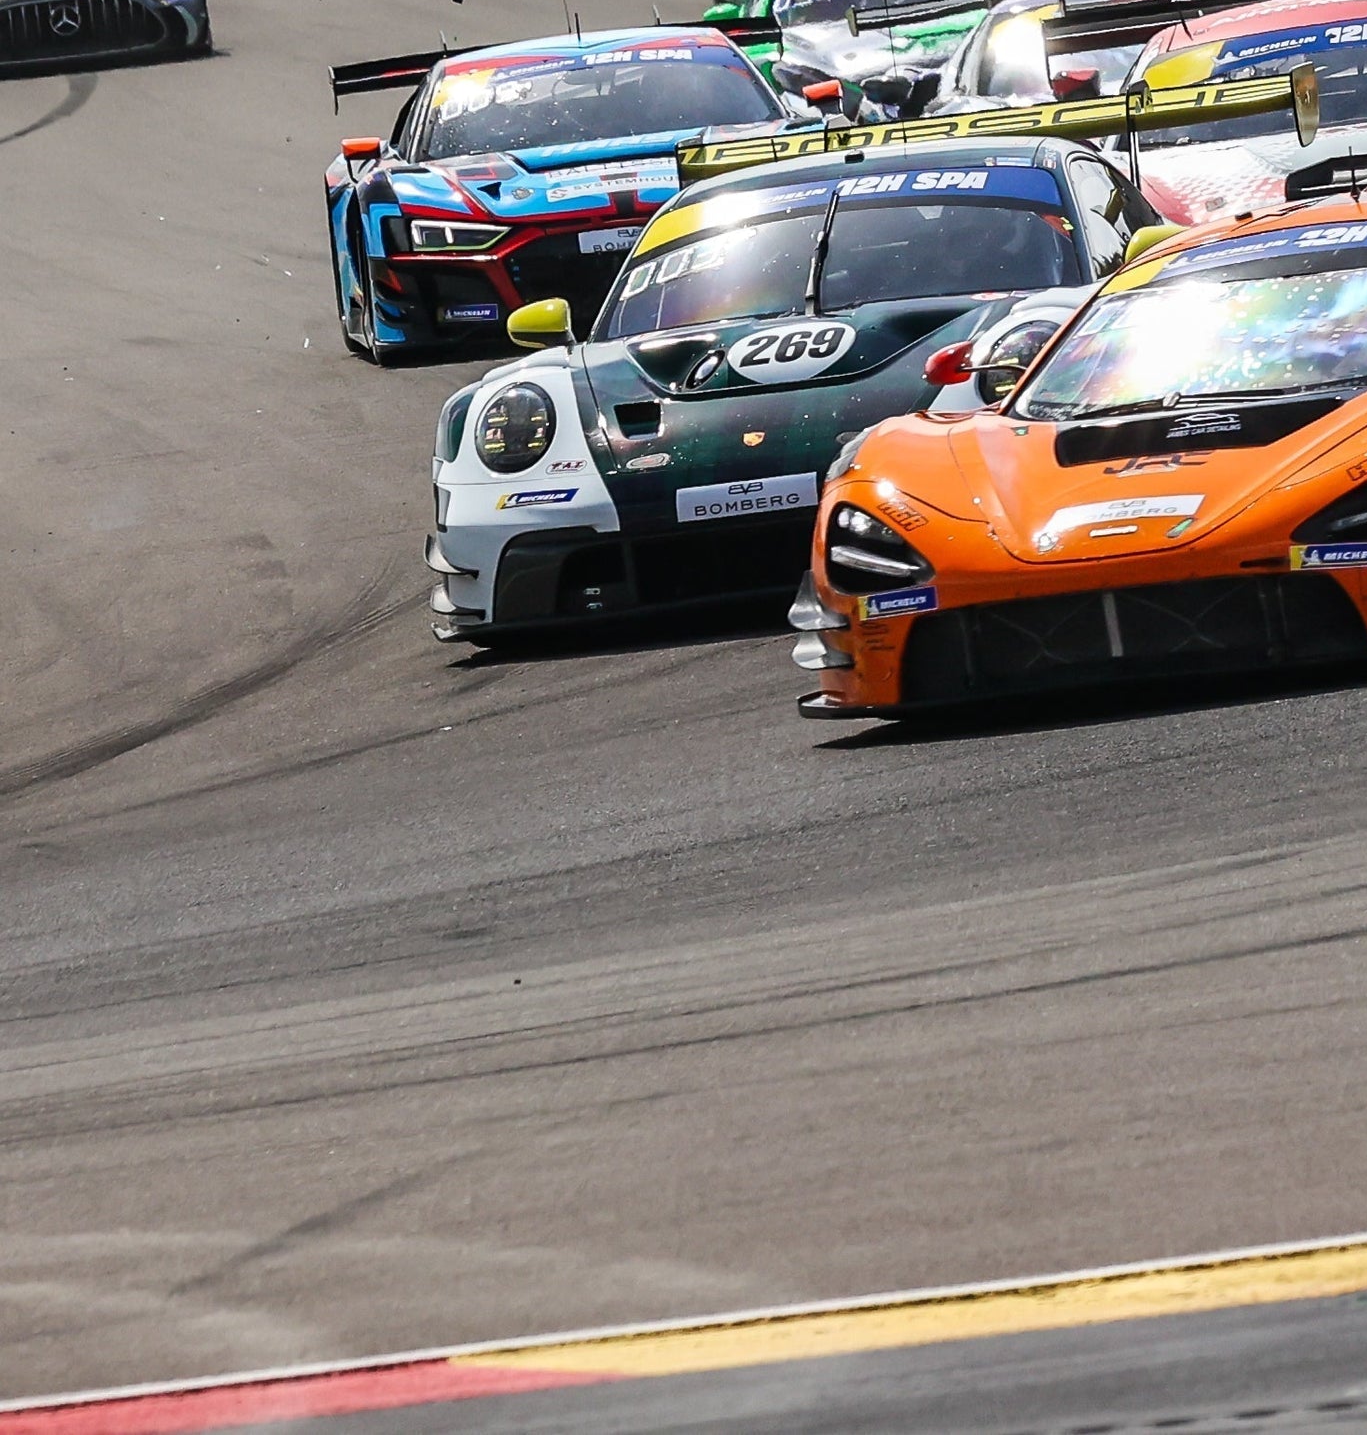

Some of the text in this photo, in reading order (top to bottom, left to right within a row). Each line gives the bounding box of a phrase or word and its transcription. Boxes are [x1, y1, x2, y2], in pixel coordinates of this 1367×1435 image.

[582, 50, 634, 66] 12H
[638, 48, 694, 62] SPA
[1238, 35, 1318, 59] MICHELIN
[573, 176, 676, 191] SYSTEMHOU
[837, 174, 906, 197] 12H
[911, 171, 989, 192] SPA
[740, 327, 845, 368] 269
[694, 493, 801, 517] BOMBERG
[880, 595, 928, 610] MICHELIN
